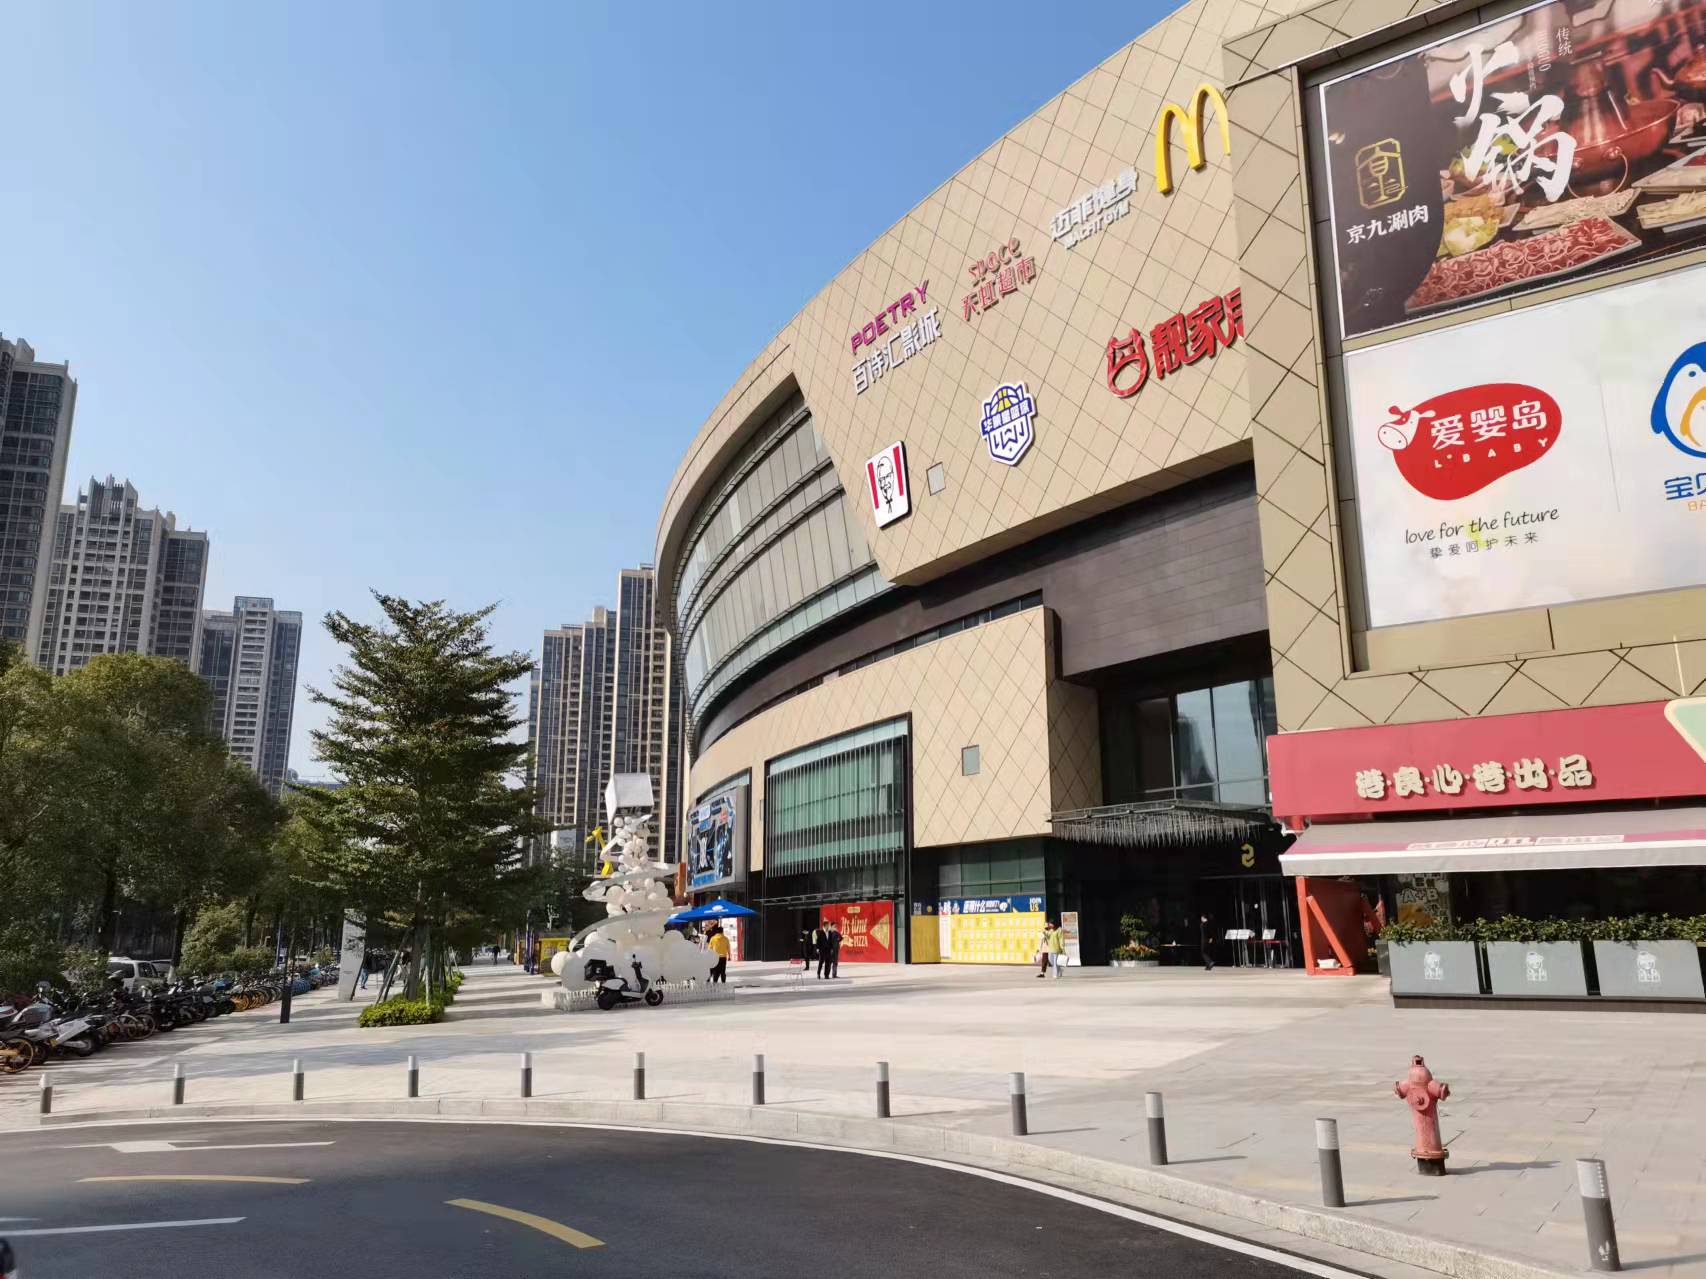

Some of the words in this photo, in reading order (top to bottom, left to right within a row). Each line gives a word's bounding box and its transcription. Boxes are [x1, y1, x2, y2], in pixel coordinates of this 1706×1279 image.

[1449, 40, 1576, 203] 火锅
[1345, 204, 1430, 245] 京九涮肉
[850, 279, 930, 355] POETRY
[851, 305, 943, 395] 百诗汇影城
[1430, 400, 1548, 451] 爱婴岛
[1404, 528, 1436, 545] love
[1439, 521, 1464, 540] for
[1468, 516, 1500, 535] the
[1503, 507, 1561, 529] future
